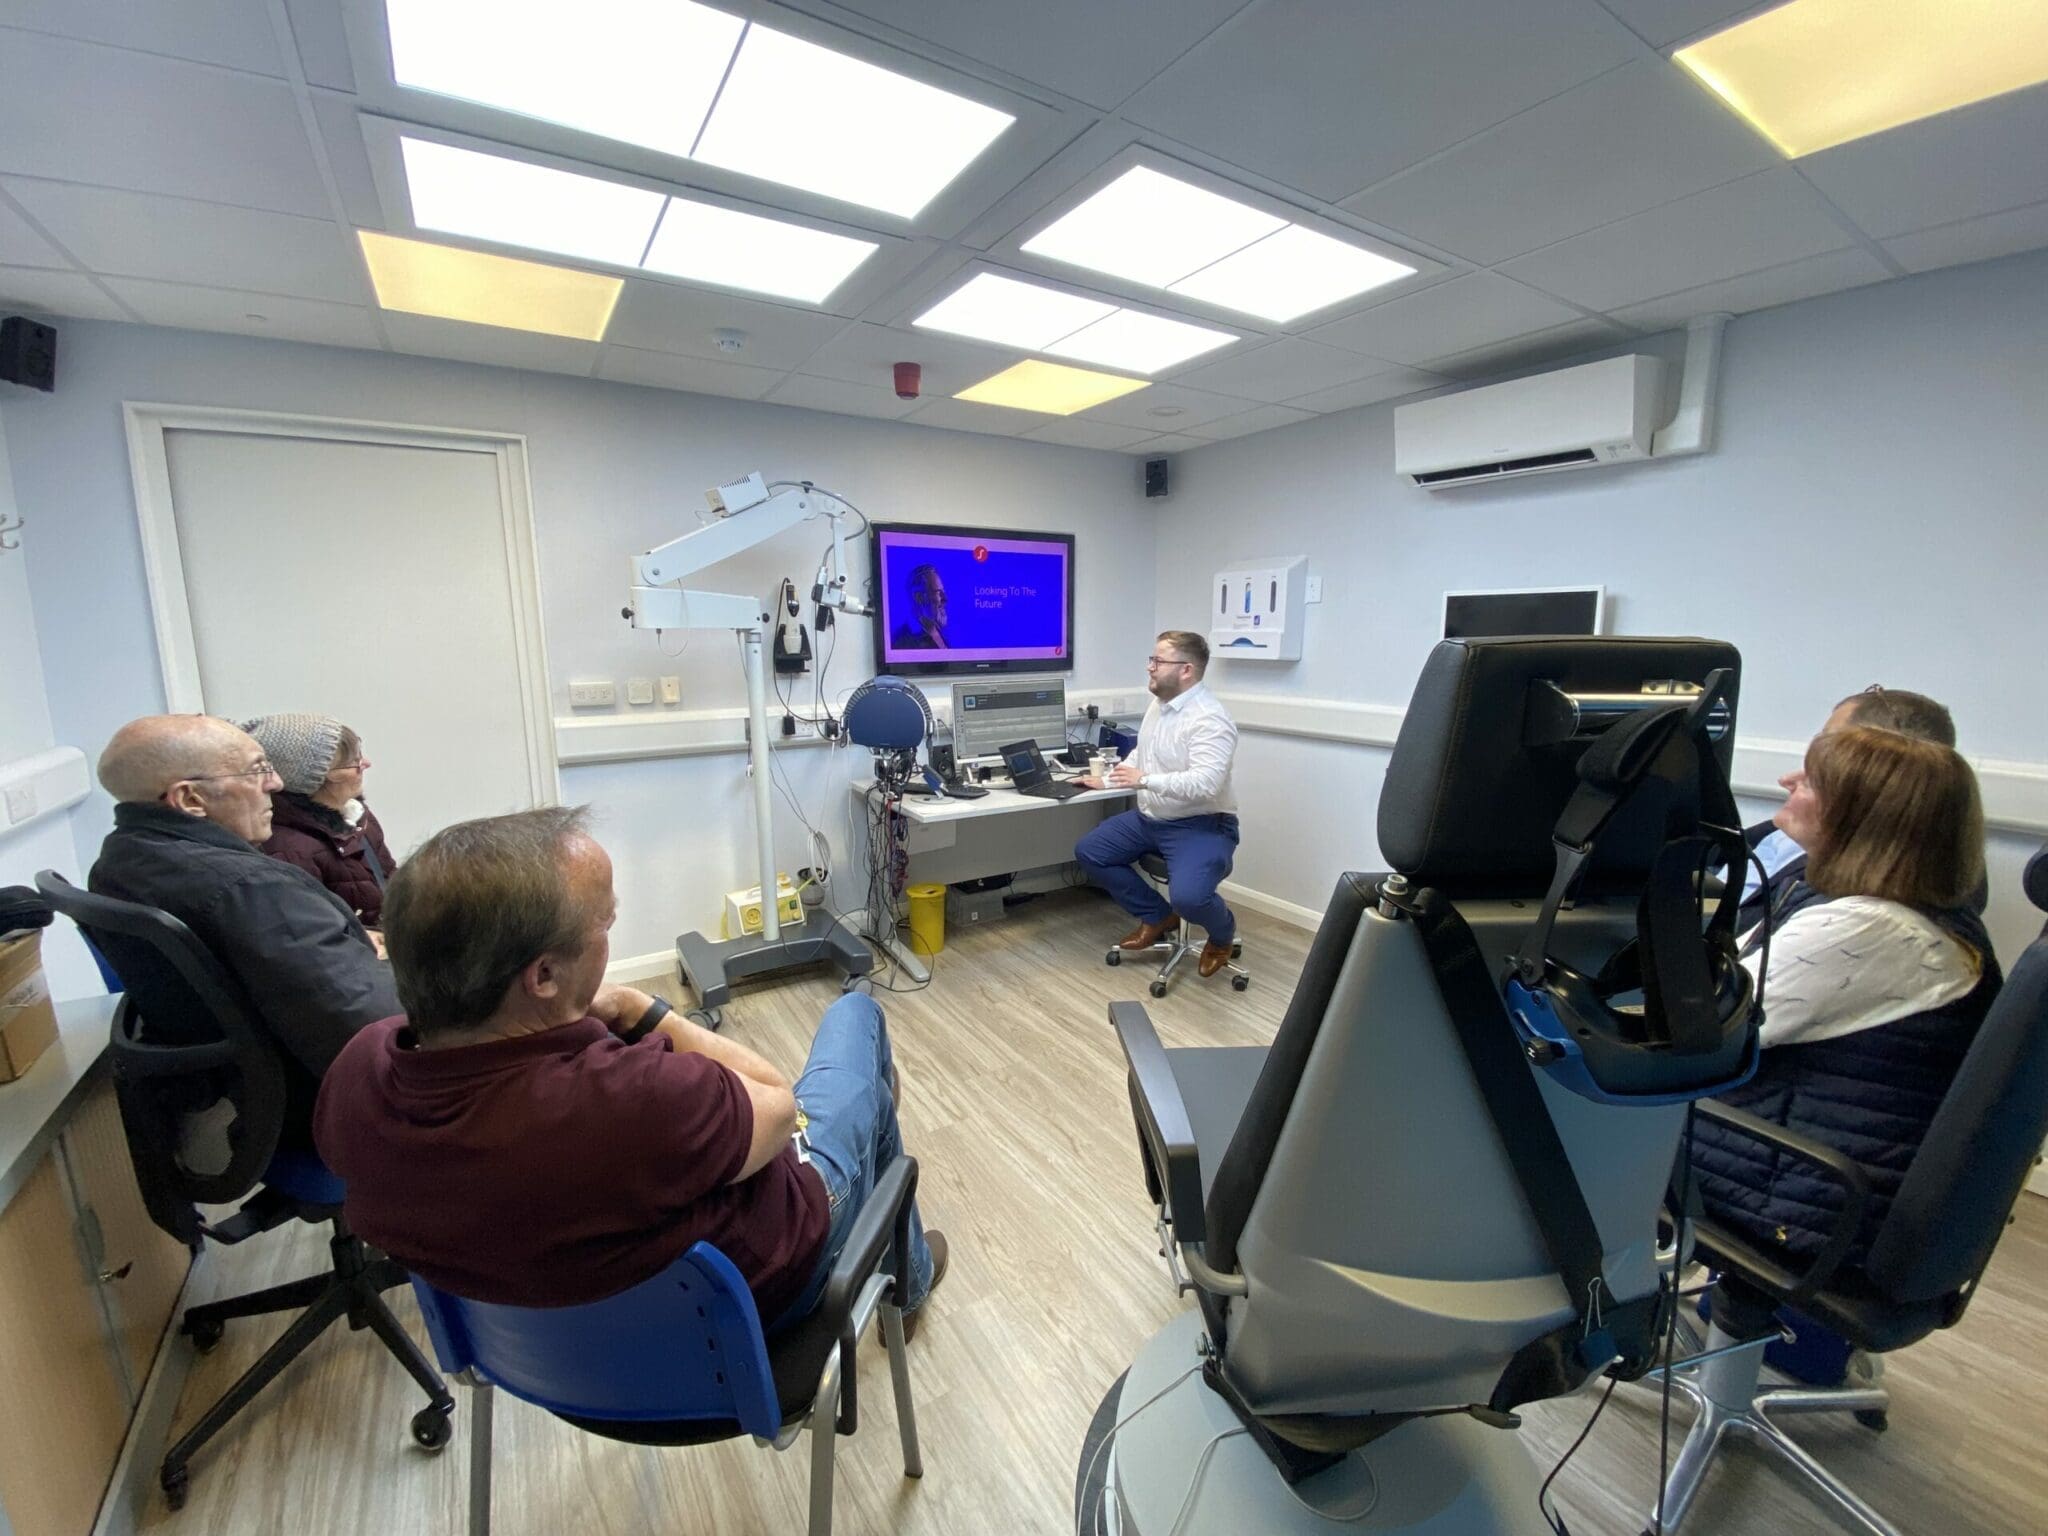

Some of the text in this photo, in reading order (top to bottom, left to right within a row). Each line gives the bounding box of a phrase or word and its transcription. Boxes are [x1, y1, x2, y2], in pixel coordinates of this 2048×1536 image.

[974, 586, 1037, 598] Looking To The
[974, 599, 1002, 609] Future
